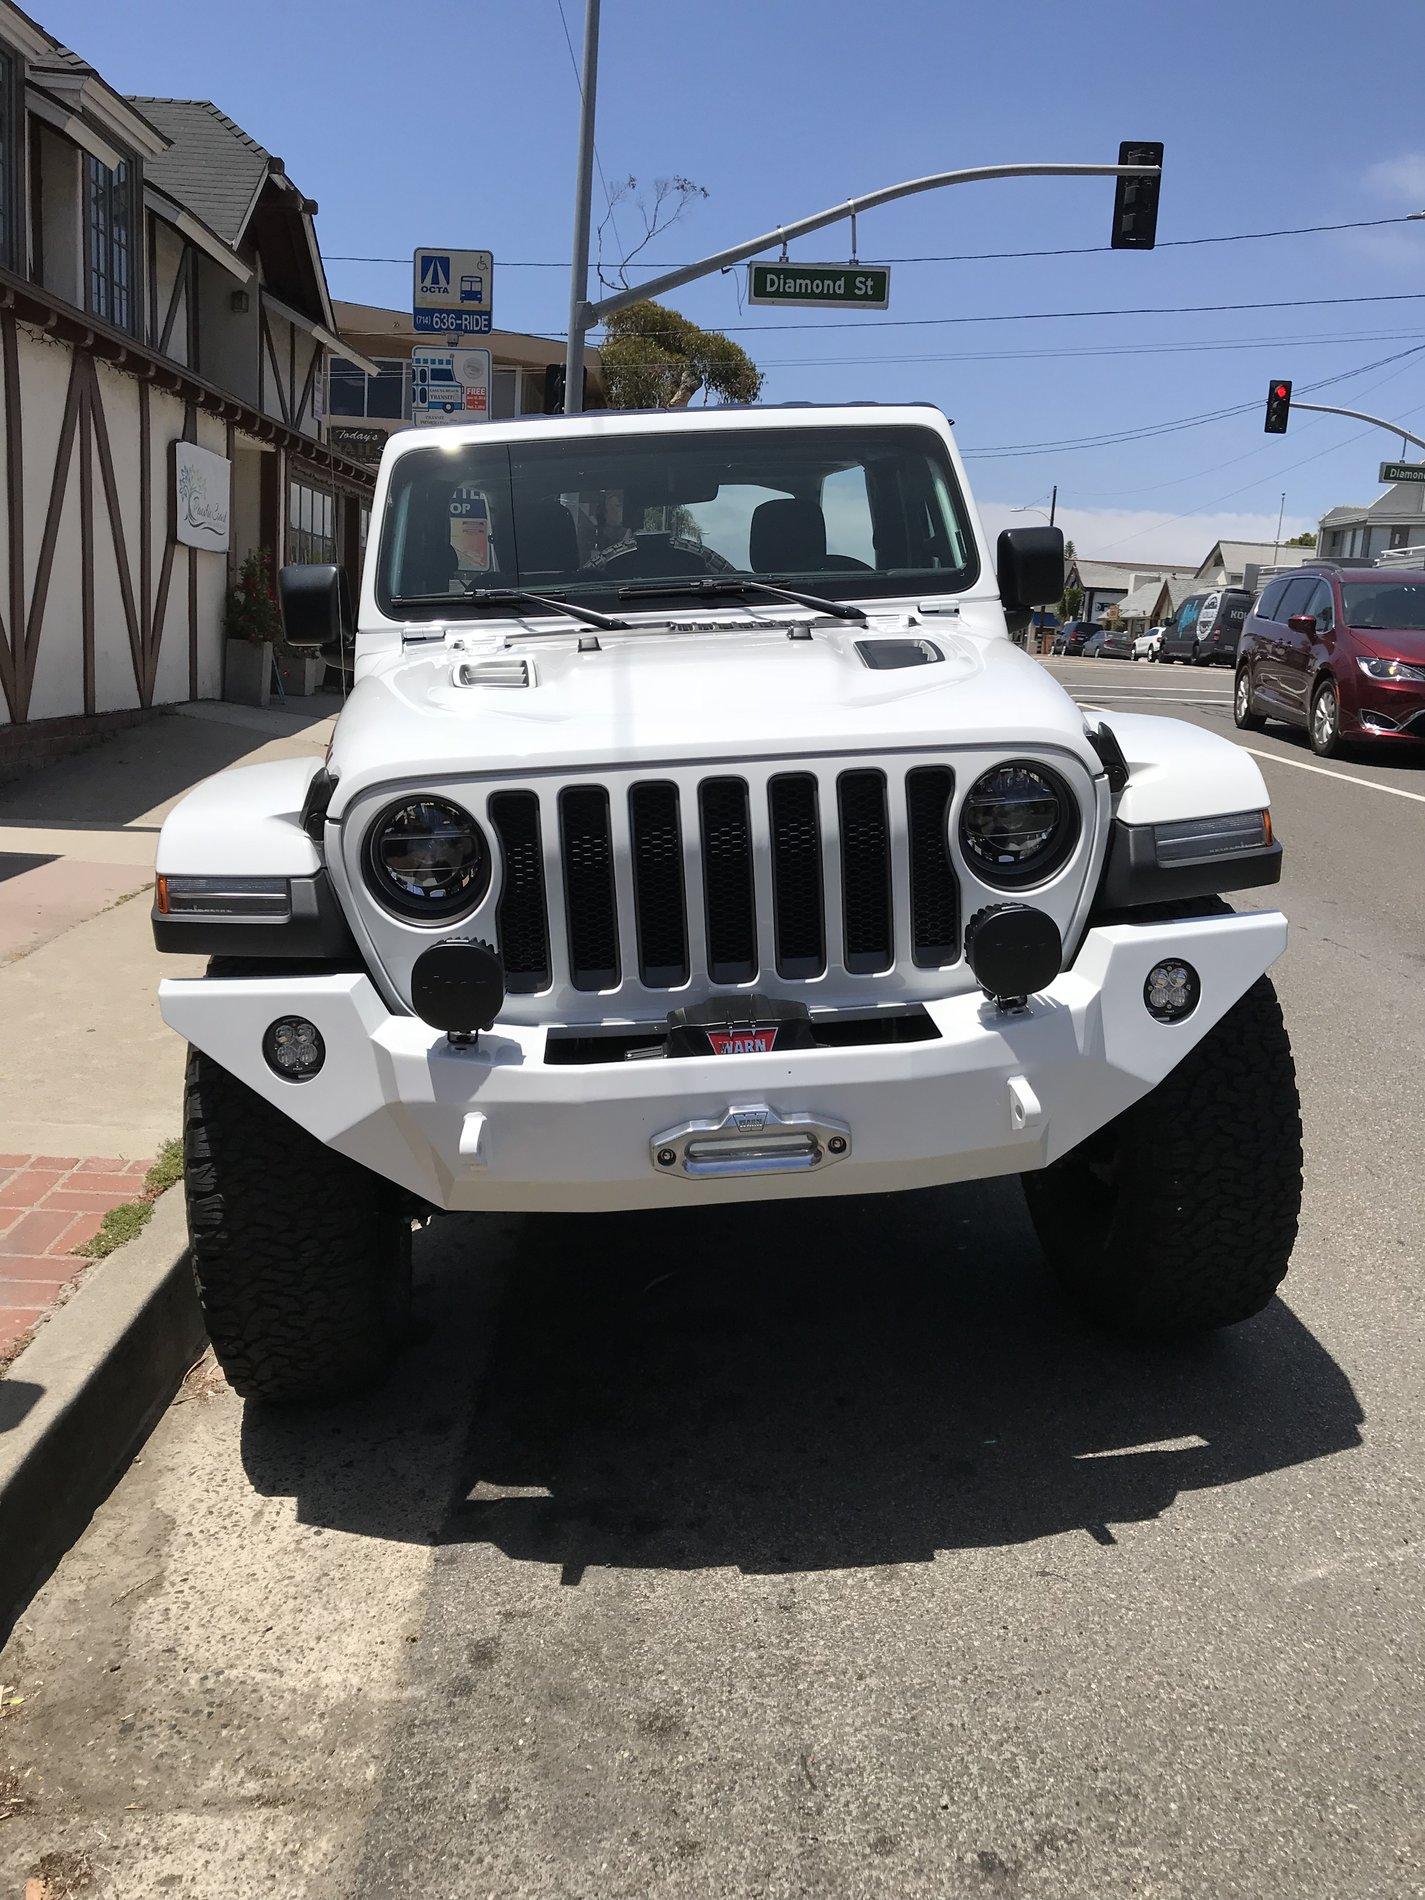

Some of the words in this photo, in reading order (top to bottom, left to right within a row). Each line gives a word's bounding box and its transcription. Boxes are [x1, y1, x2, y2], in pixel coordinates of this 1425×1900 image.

[420, 285, 450, 294] OCTA
[766, 273, 845, 294] Diamond
[854, 276, 874, 295] St
[416, 315, 431, 325] (714)
[432, 313, 489, 331] 636-RIDE
[466, 387, 486, 395] FREE
[336, 430, 379, 442] Today's
[1390, 468, 1425, 480] Diamon
[449, 502, 471, 514] OP
[1230, 610, 1247, 620] KO
[719, 1038, 766, 1054] WARN
